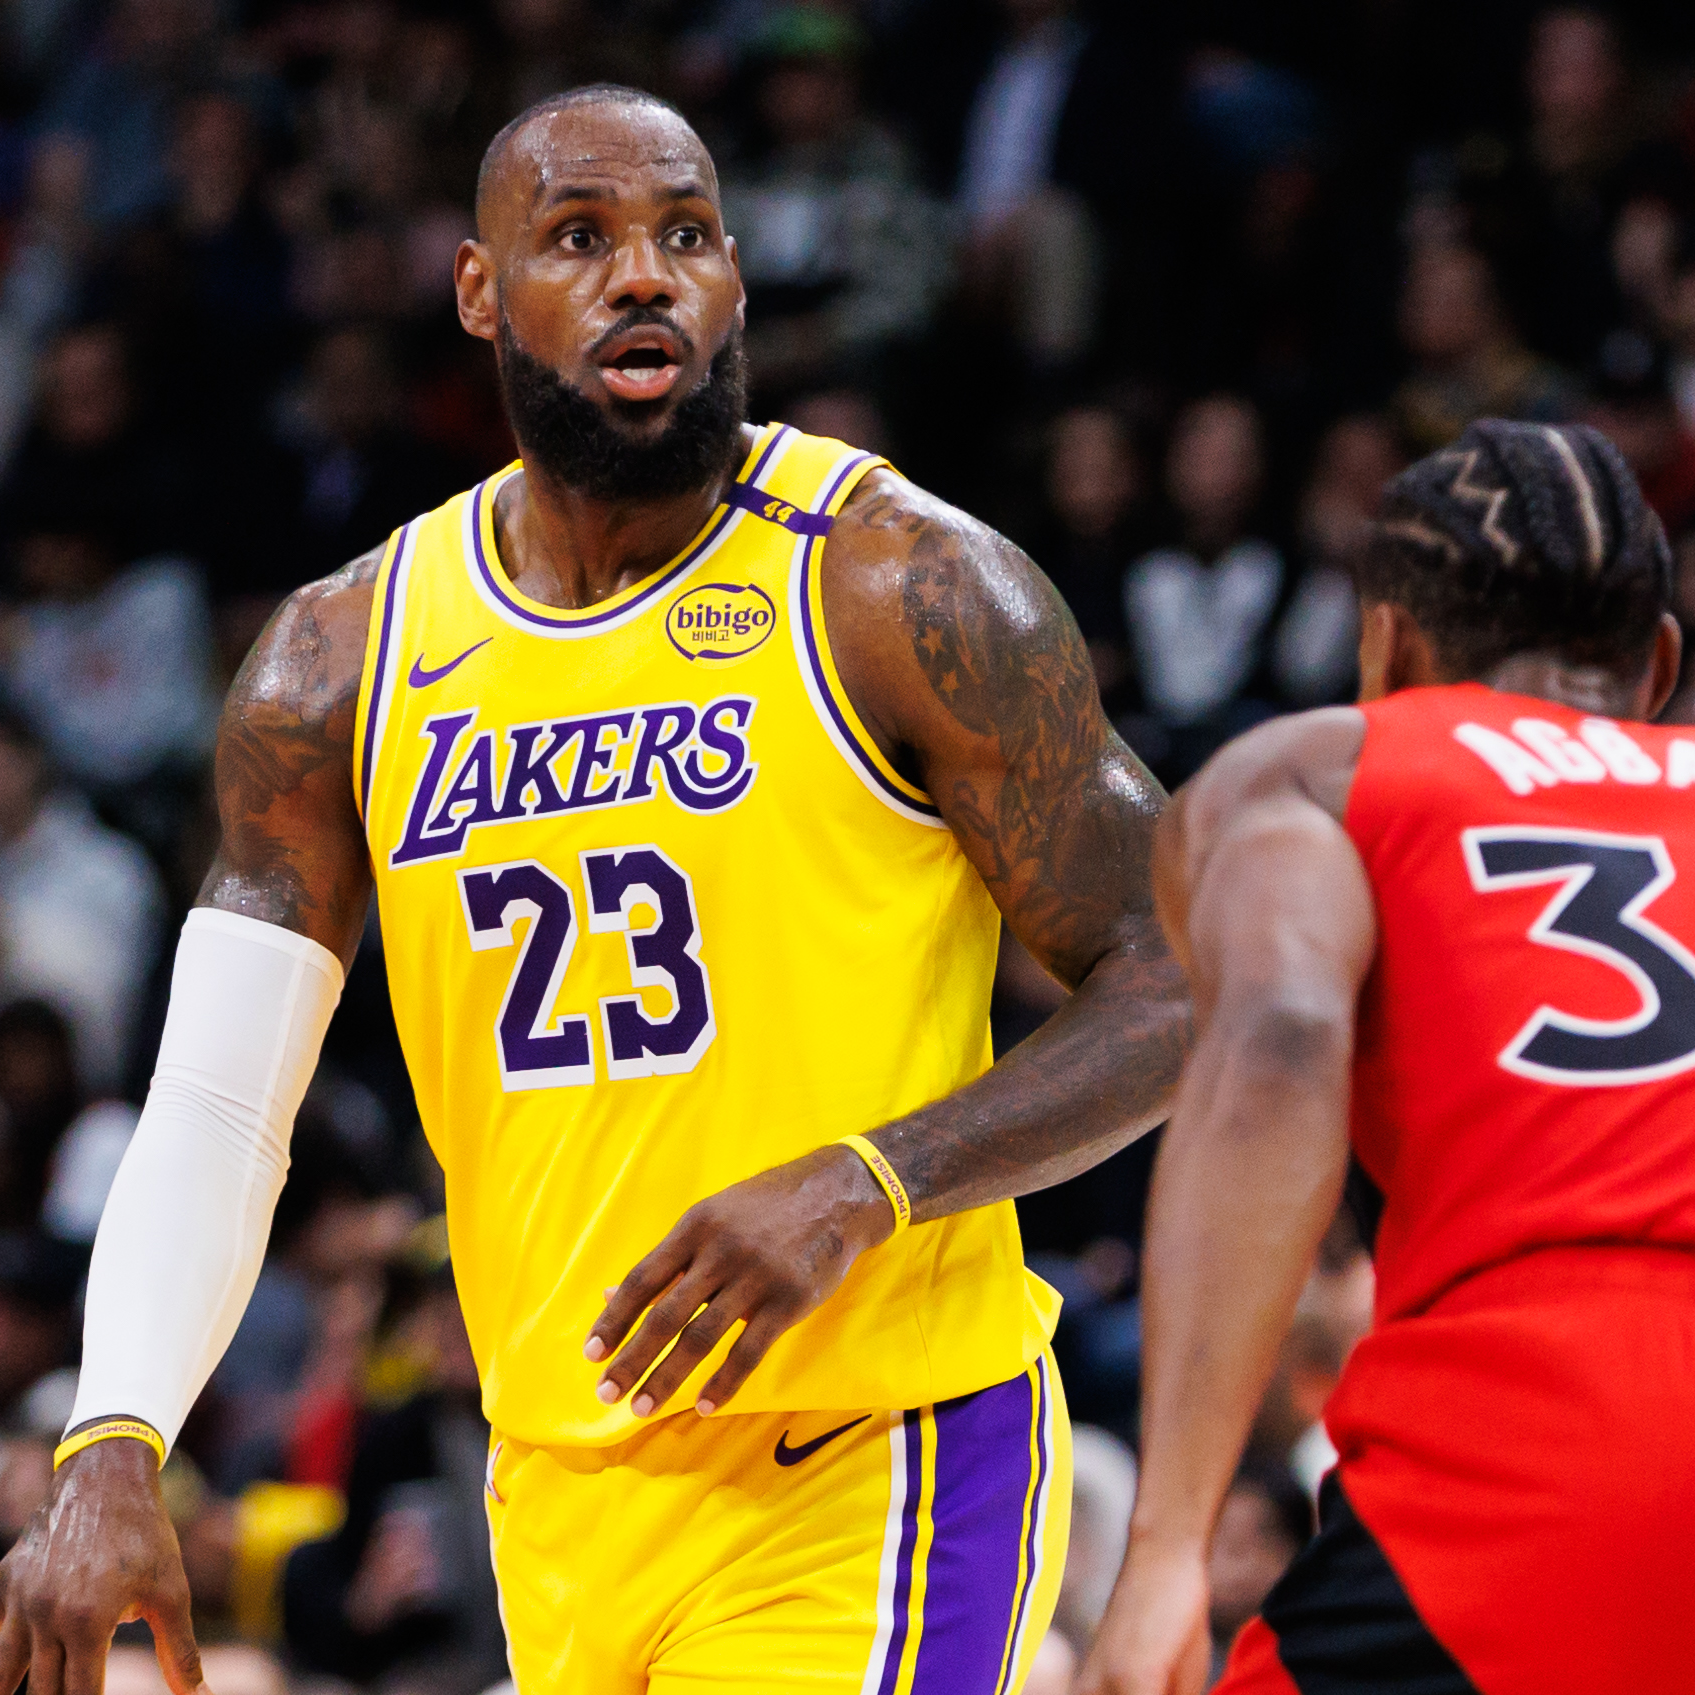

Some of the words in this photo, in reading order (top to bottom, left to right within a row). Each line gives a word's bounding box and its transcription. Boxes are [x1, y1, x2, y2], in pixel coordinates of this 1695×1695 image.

[763, 500, 796, 523] 44
[677, 603, 769, 635] bibigo
[692, 629, 730, 643] 비비고
[389, 696, 757, 870] LAKERS
[456, 844, 717, 1092] 23
[871, 1155, 907, 1213] PROMISE
[87, 1424, 148, 1440] PROMISE
